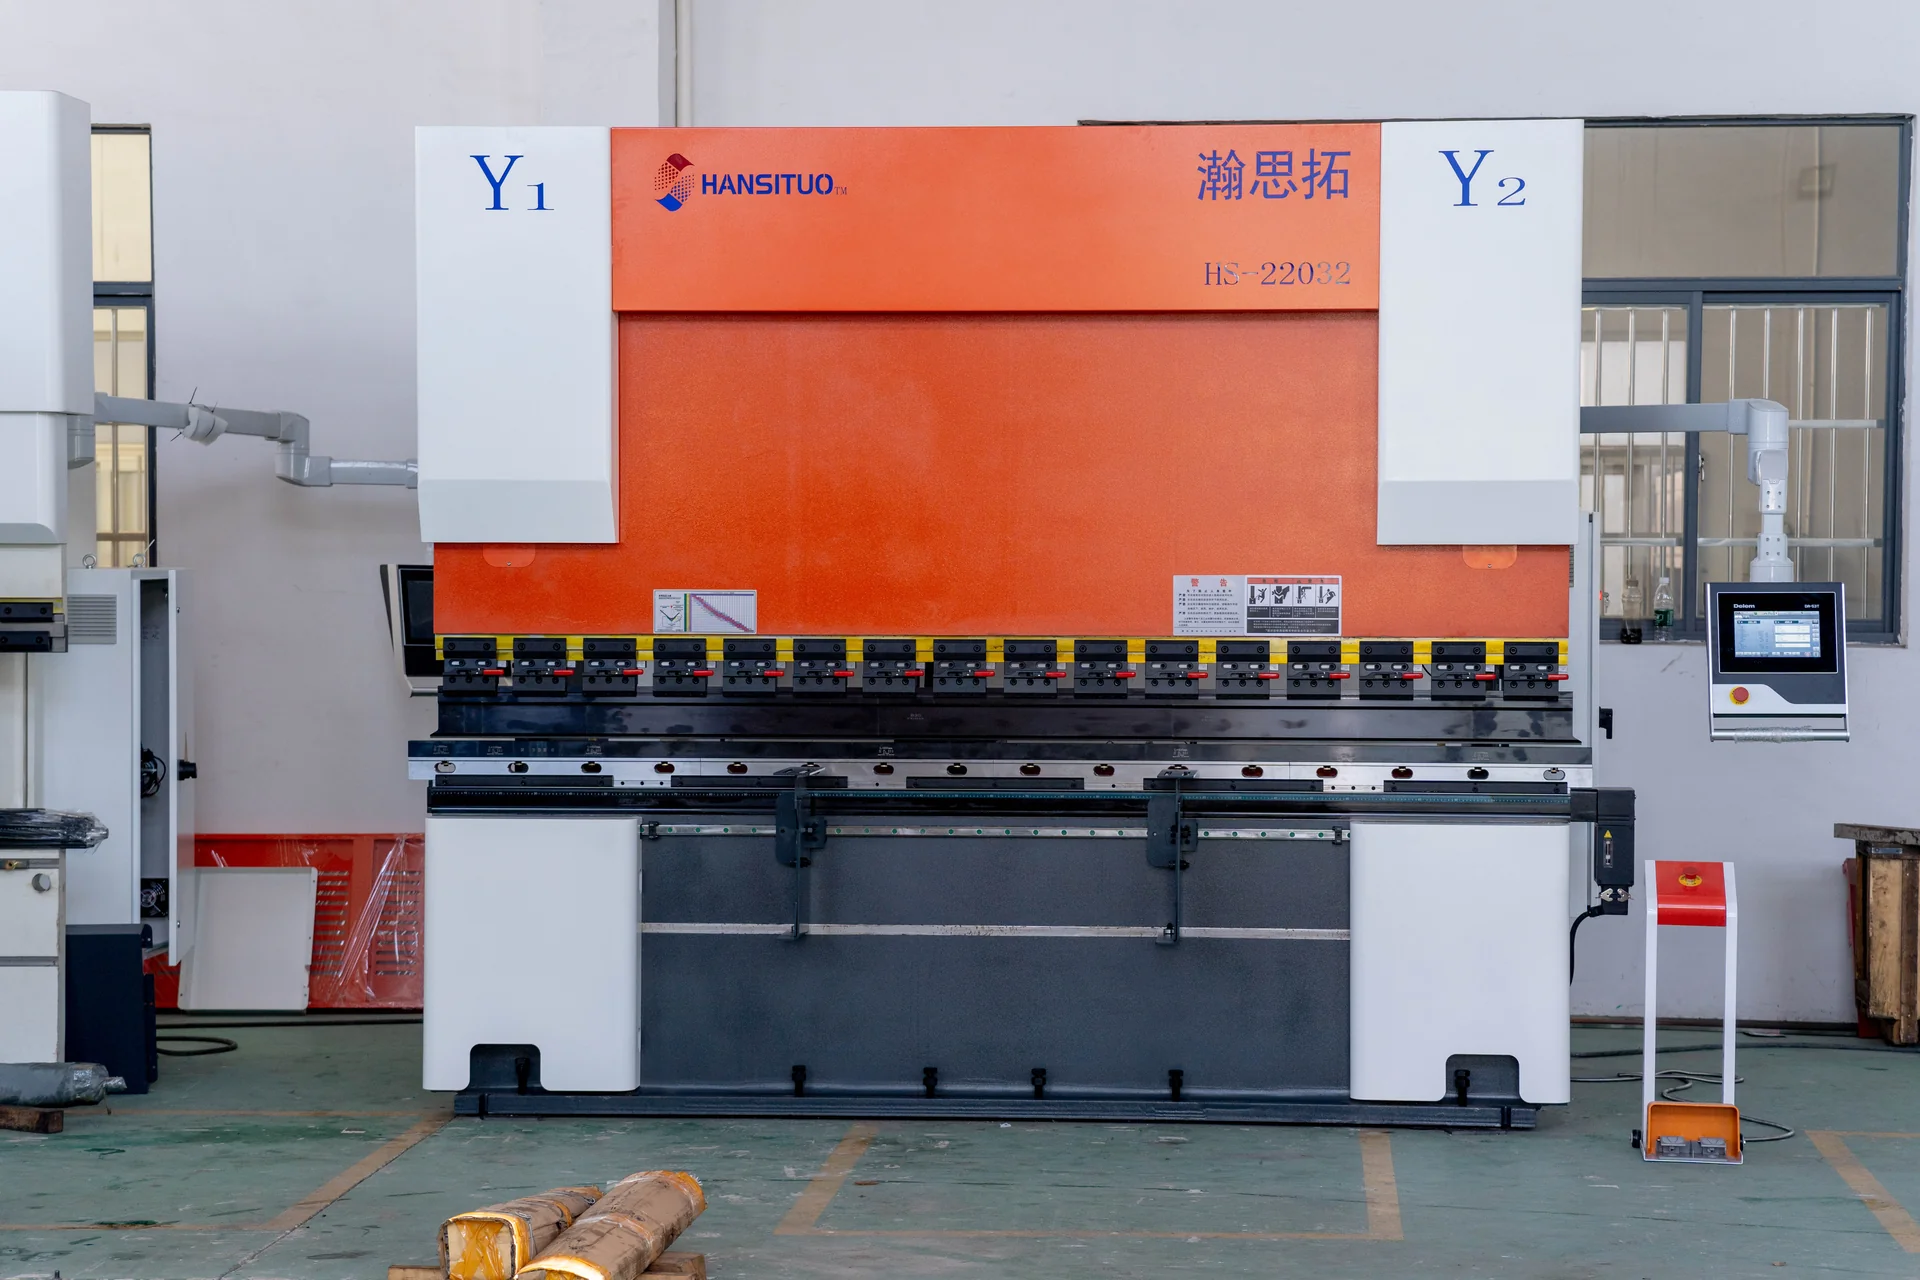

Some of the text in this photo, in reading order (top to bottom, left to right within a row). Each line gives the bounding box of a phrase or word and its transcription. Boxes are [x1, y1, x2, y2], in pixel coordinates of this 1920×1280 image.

[701, 173, 833, 195] HANSITUO
[1197, 148, 1352, 201] 瀚思拓
[1204, 262, 1351, 286] HS-22032
